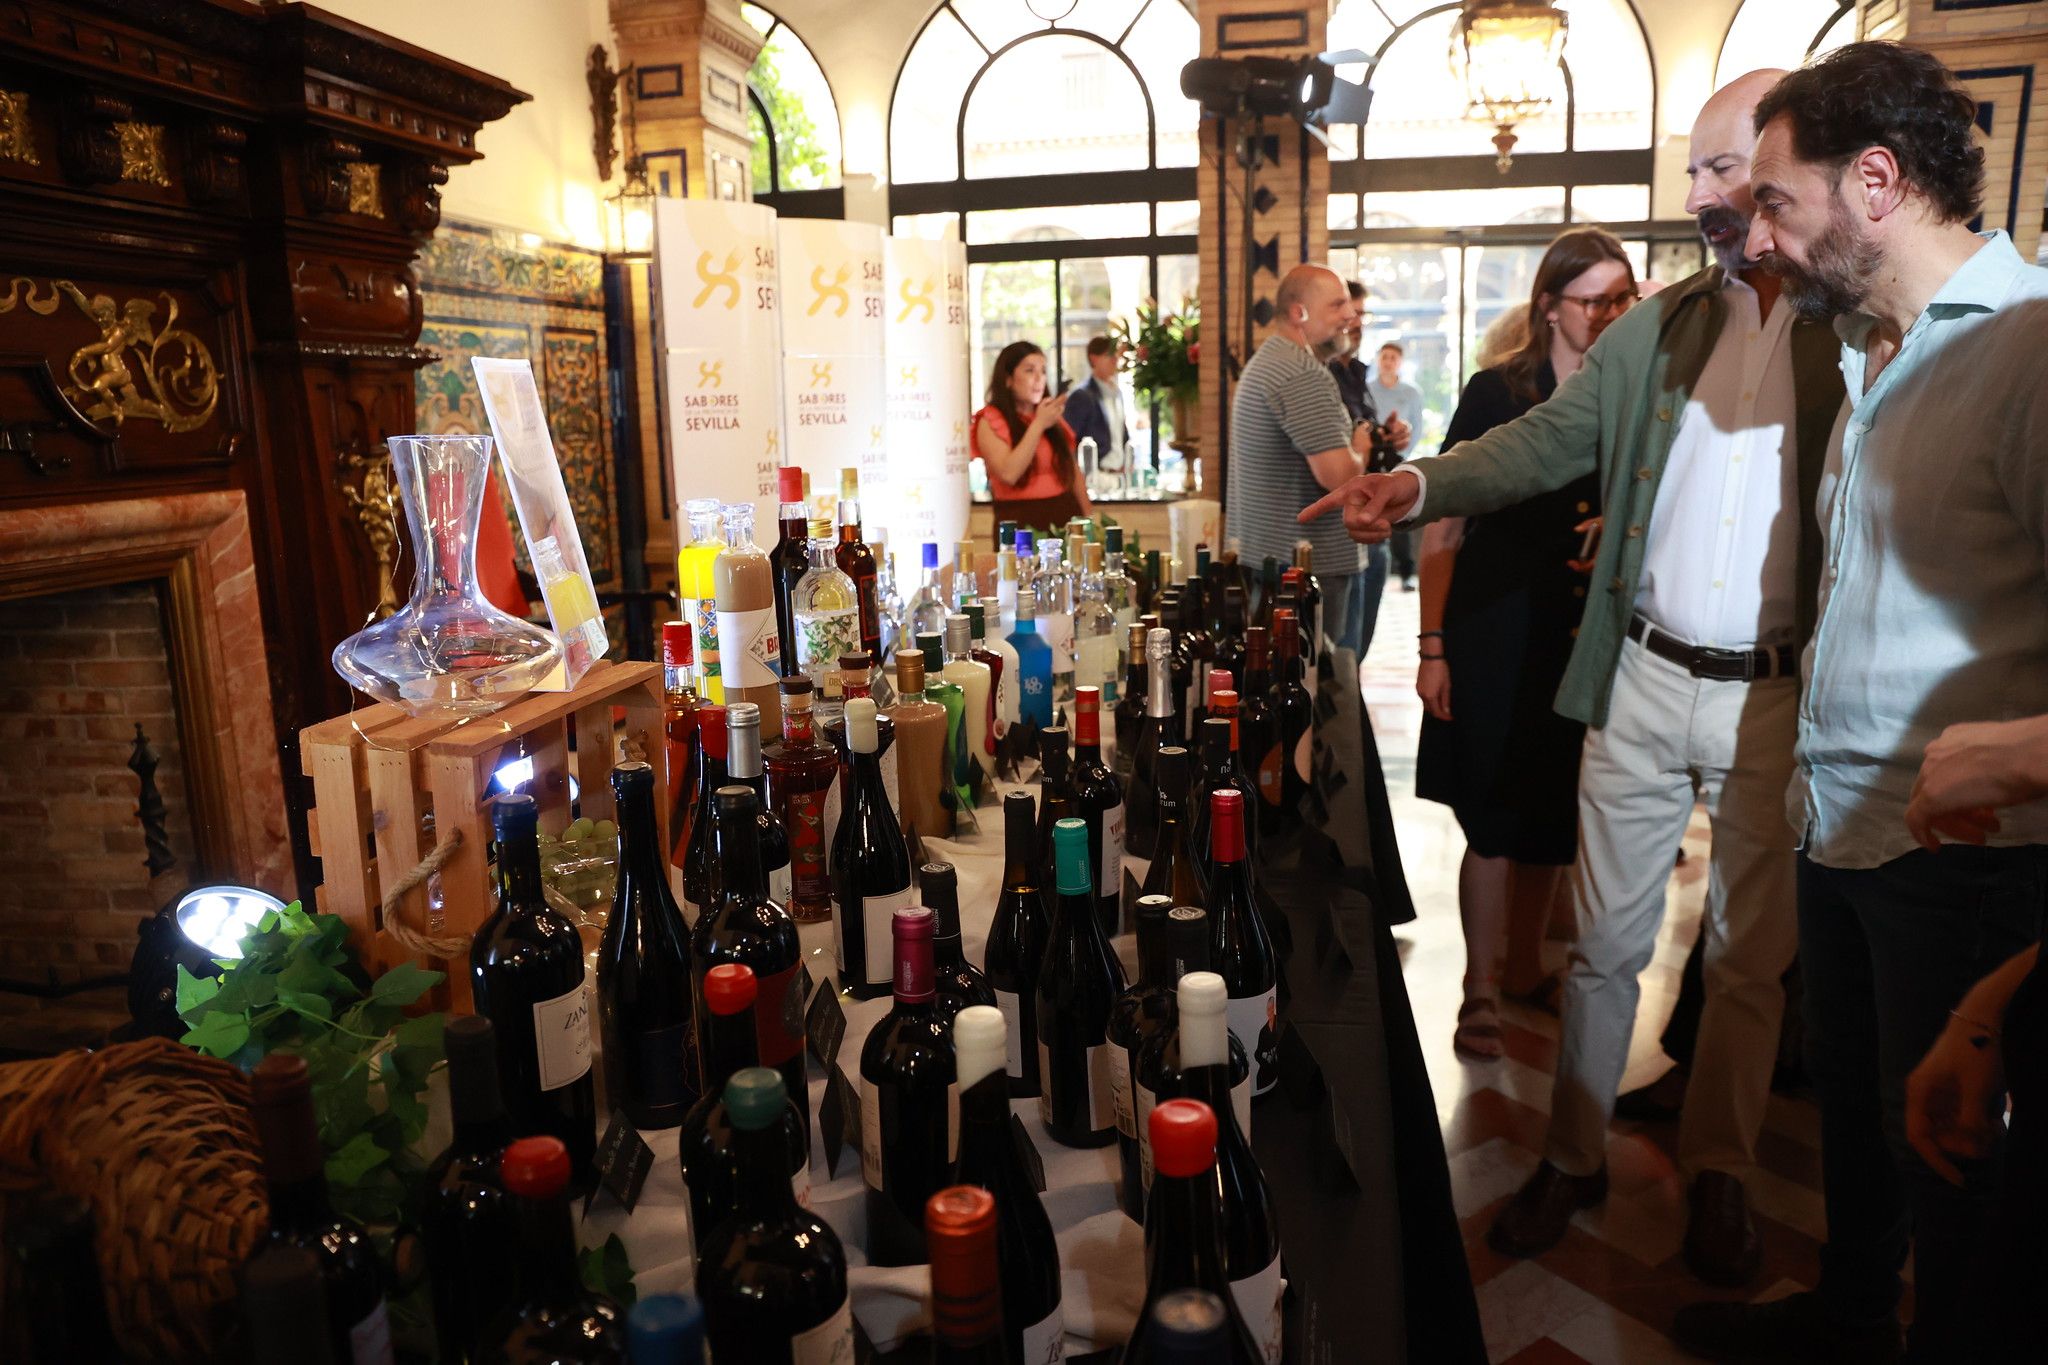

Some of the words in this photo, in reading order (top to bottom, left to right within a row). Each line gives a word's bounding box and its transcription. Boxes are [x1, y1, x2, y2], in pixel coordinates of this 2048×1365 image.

[684, 394, 739, 408] SABORES
[685, 416, 741, 432] SEVILLA
[799, 413, 848, 426] SEVILLA
